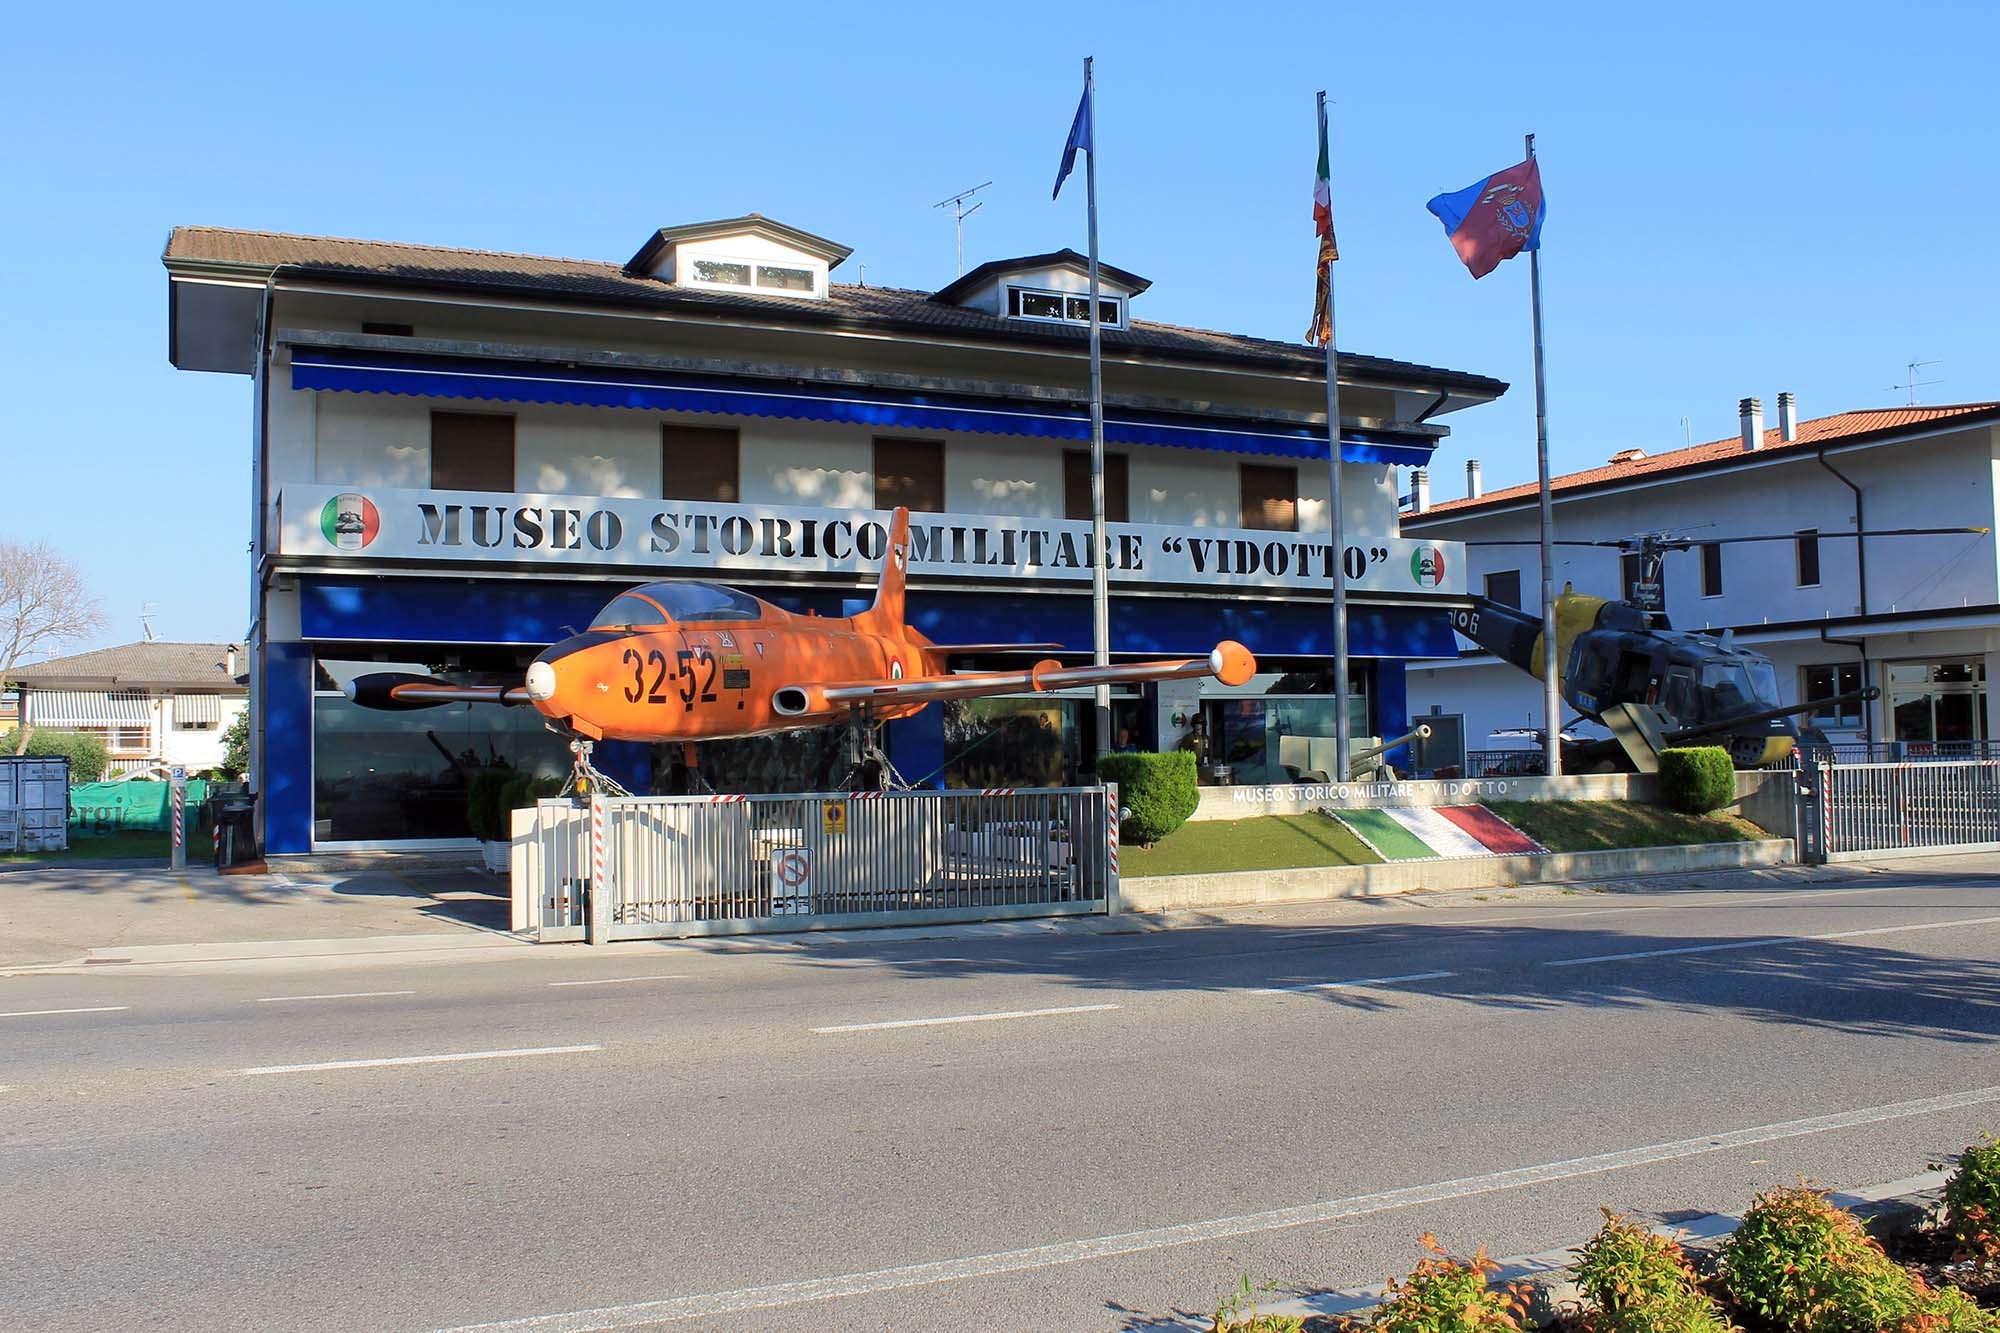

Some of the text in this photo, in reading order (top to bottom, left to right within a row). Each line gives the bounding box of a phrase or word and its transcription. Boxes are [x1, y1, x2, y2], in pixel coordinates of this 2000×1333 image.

[417, 503, 623, 551] MUSEO
[650, 512, 887, 560] STORICO
[908, 525, 1143, 570] MILITARE
[1233, 787, 1283, 802] MUSEO
[1288, 785, 1349, 800] STORICO
[1353, 783, 1413, 799] MILITARE
